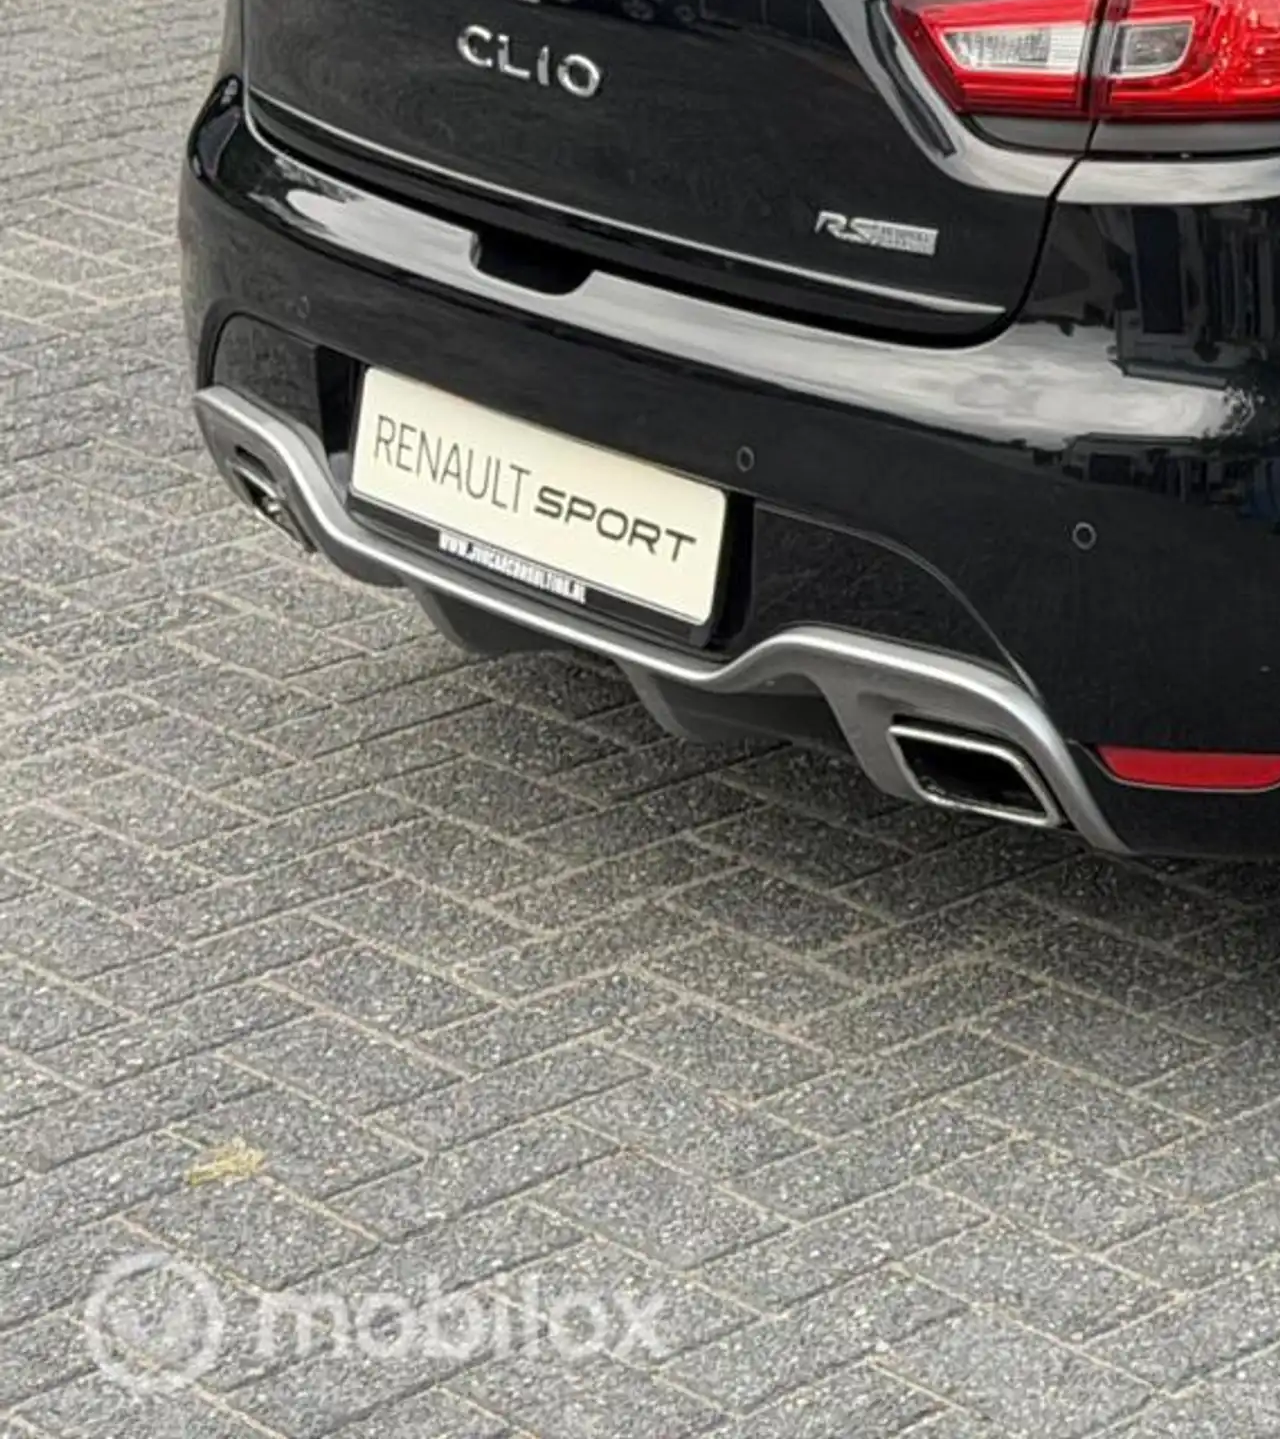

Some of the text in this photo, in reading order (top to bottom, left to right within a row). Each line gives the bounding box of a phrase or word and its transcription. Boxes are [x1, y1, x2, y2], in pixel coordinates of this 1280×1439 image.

[457, 24, 600, 98] CLIO
[373, 414, 697, 563] RENAULT SPORT
